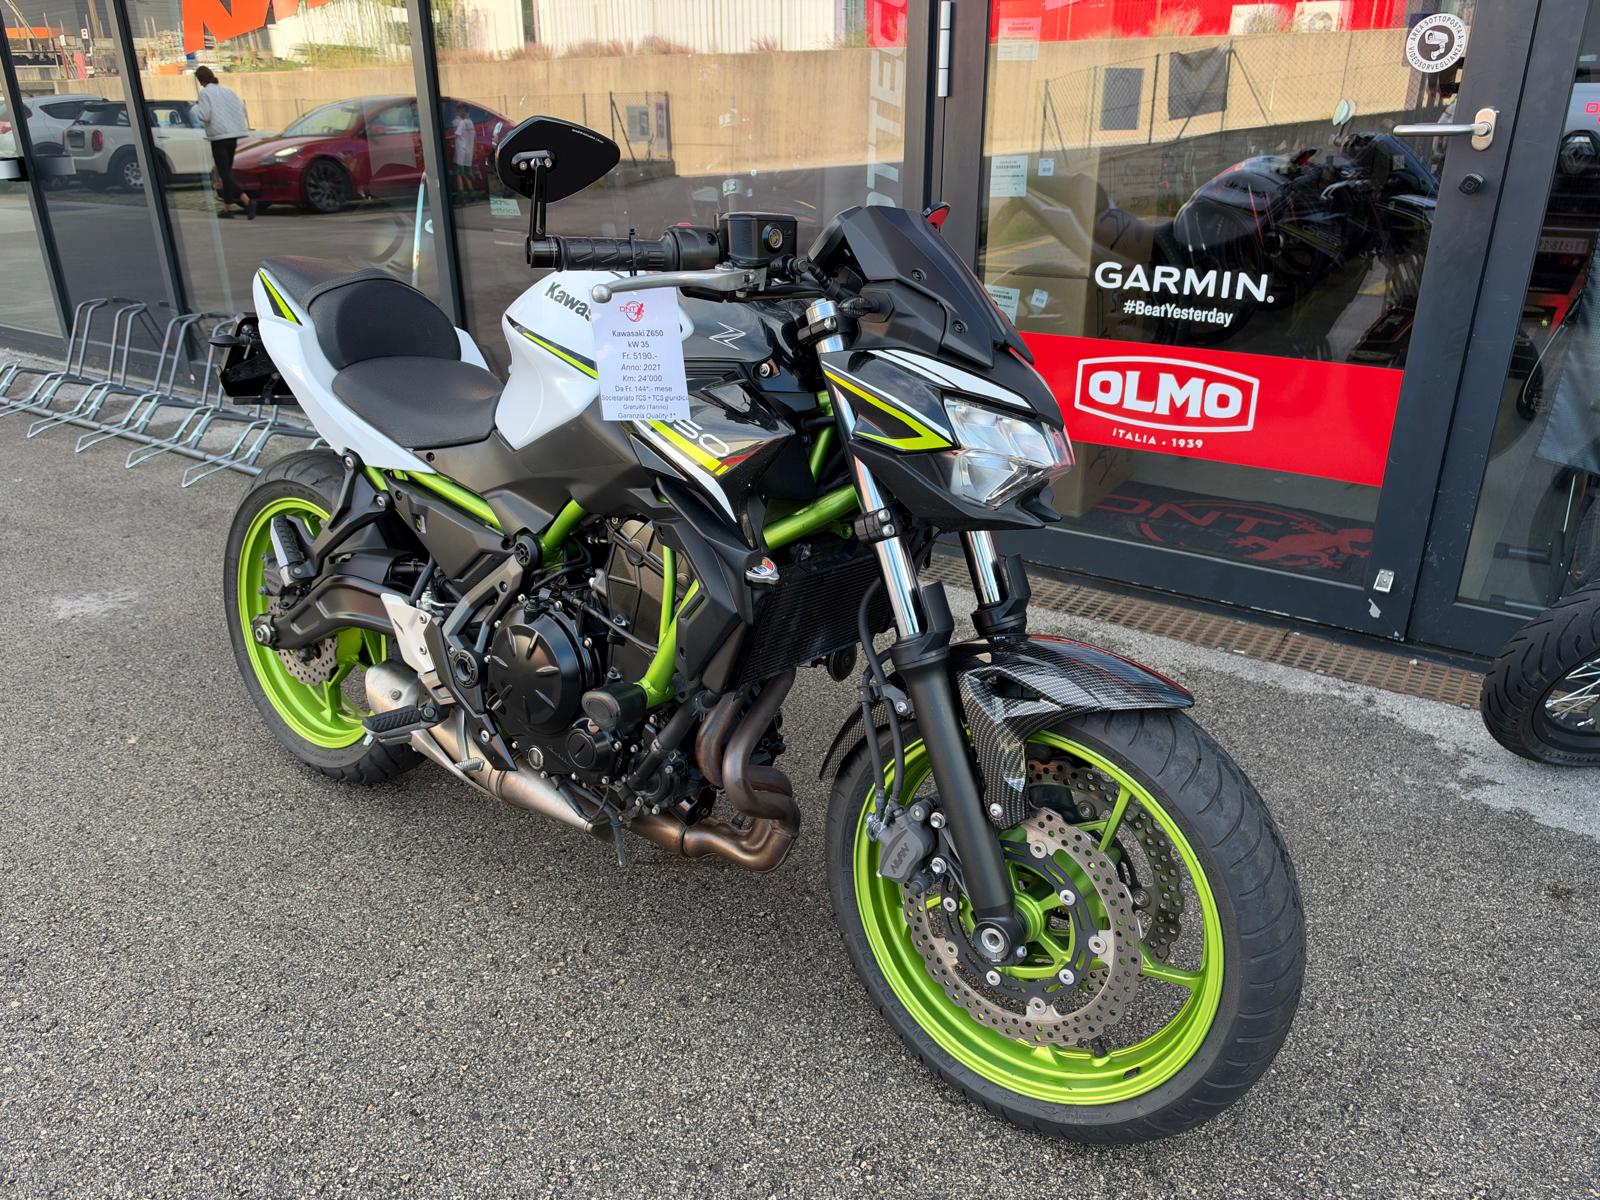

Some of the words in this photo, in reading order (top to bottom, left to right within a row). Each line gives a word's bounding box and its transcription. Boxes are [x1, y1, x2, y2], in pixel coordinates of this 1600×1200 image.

[1410, 24, 1425, 41] AREA
[1424, 15, 1463, 34] SOTTOPOSTA
[1408, 44, 1464, 71] VIDEOSORVEGLIANZA
[1123, 299, 1233, 328] #BeatYesterday
[622, 352, 632, 360] Fr.
[633, 352, 657, 360] 5190.-
[1088, 370, 1243, 419] OLMO
[1112, 427, 1157, 445] ITALIA
[1171, 437, 1204, 449] 1939
